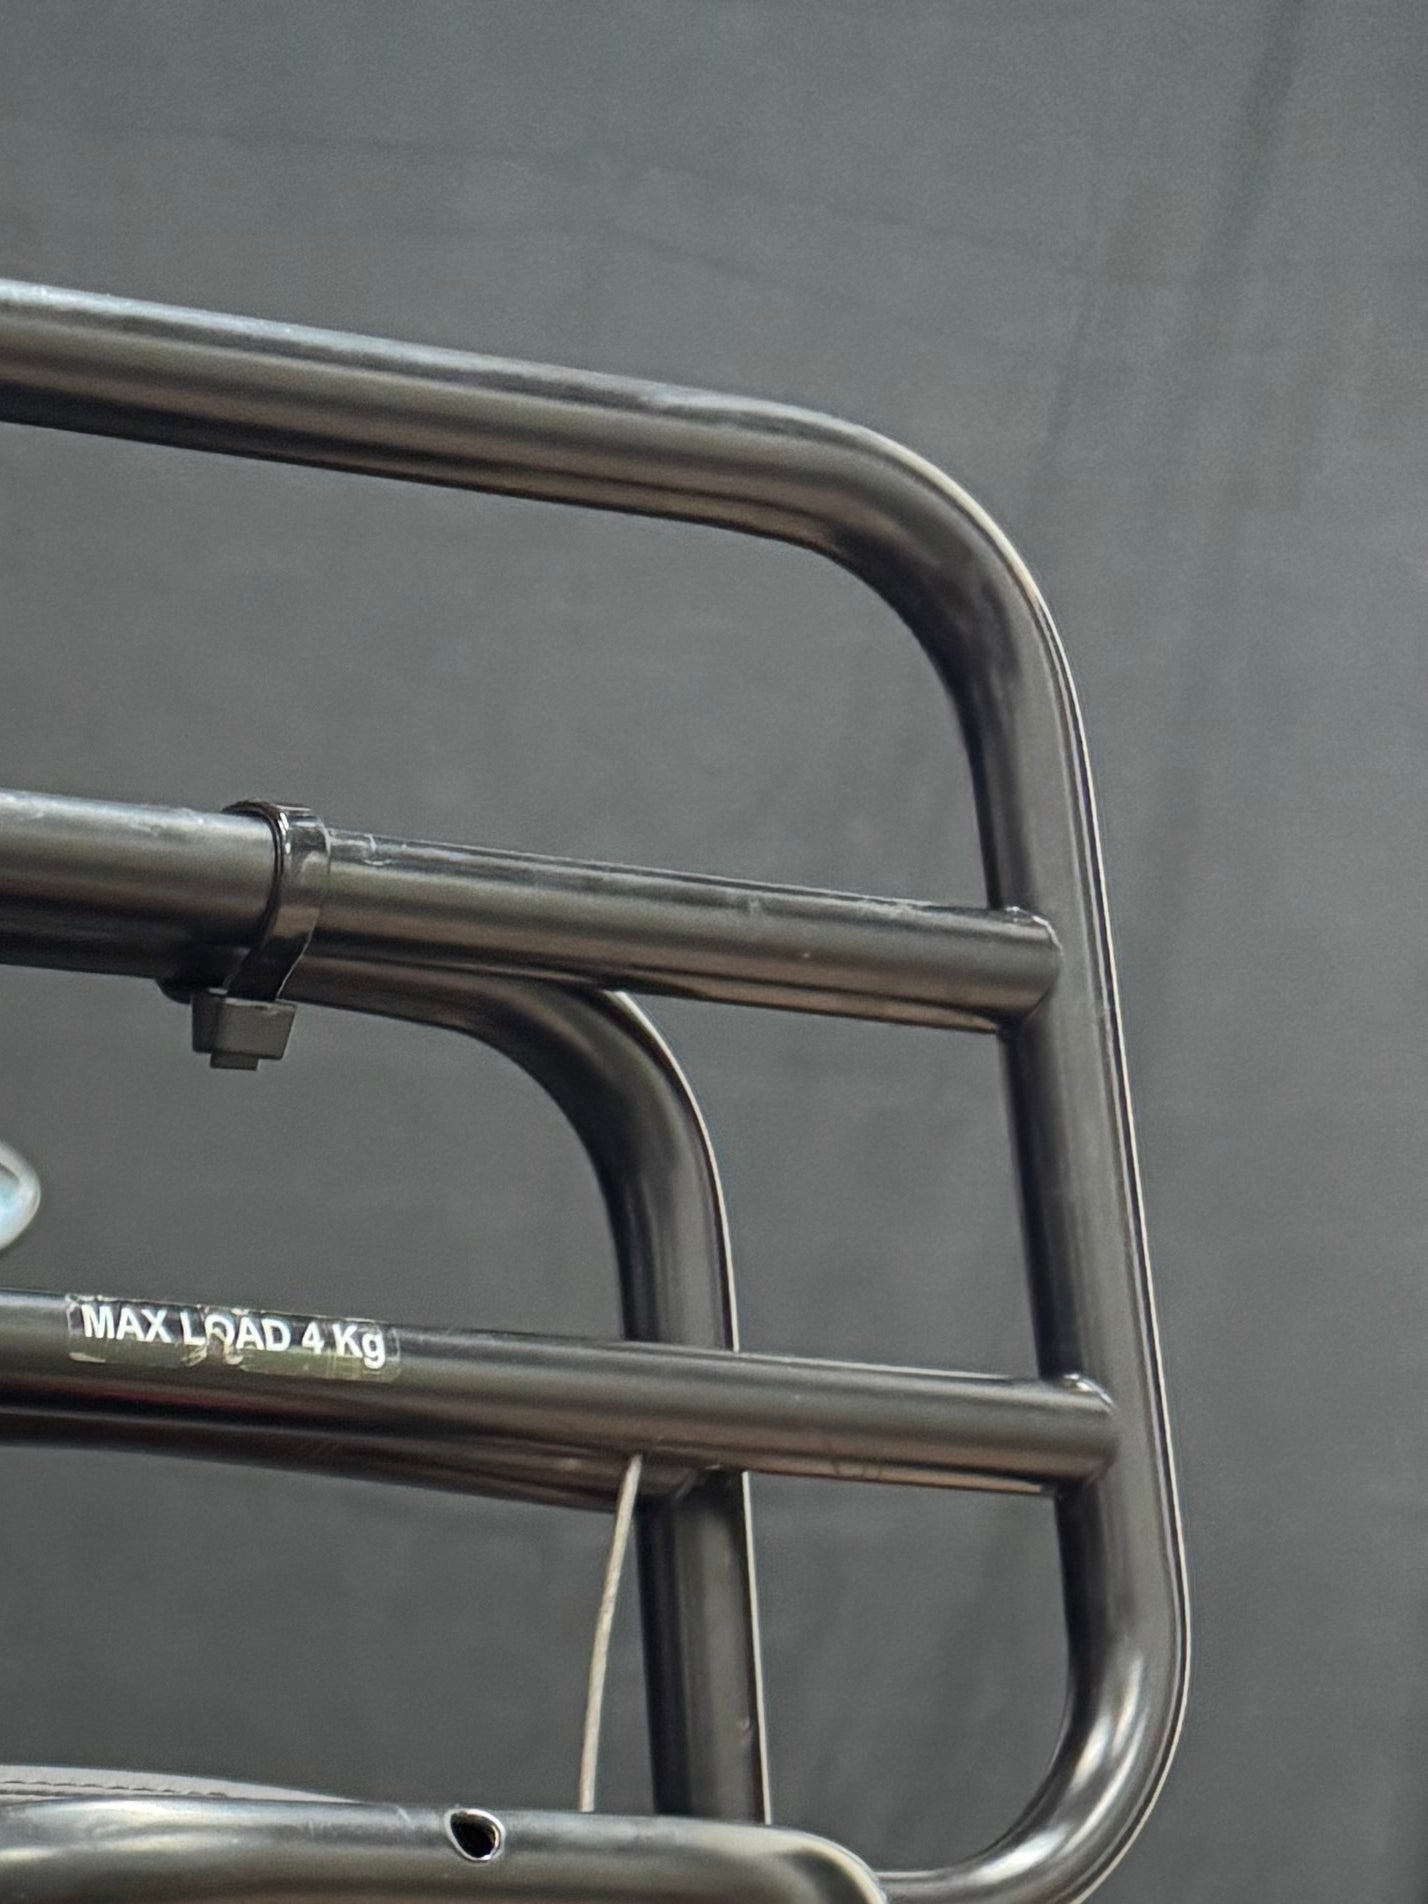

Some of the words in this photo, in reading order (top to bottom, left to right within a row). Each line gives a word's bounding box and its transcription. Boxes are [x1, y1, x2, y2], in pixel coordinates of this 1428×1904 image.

[79, 1302, 173, 1344] MAX
[179, 1309, 292, 1353] LOAD
[300, 1320, 325, 1356] 4
[332, 1320, 387, 1371] Kg
